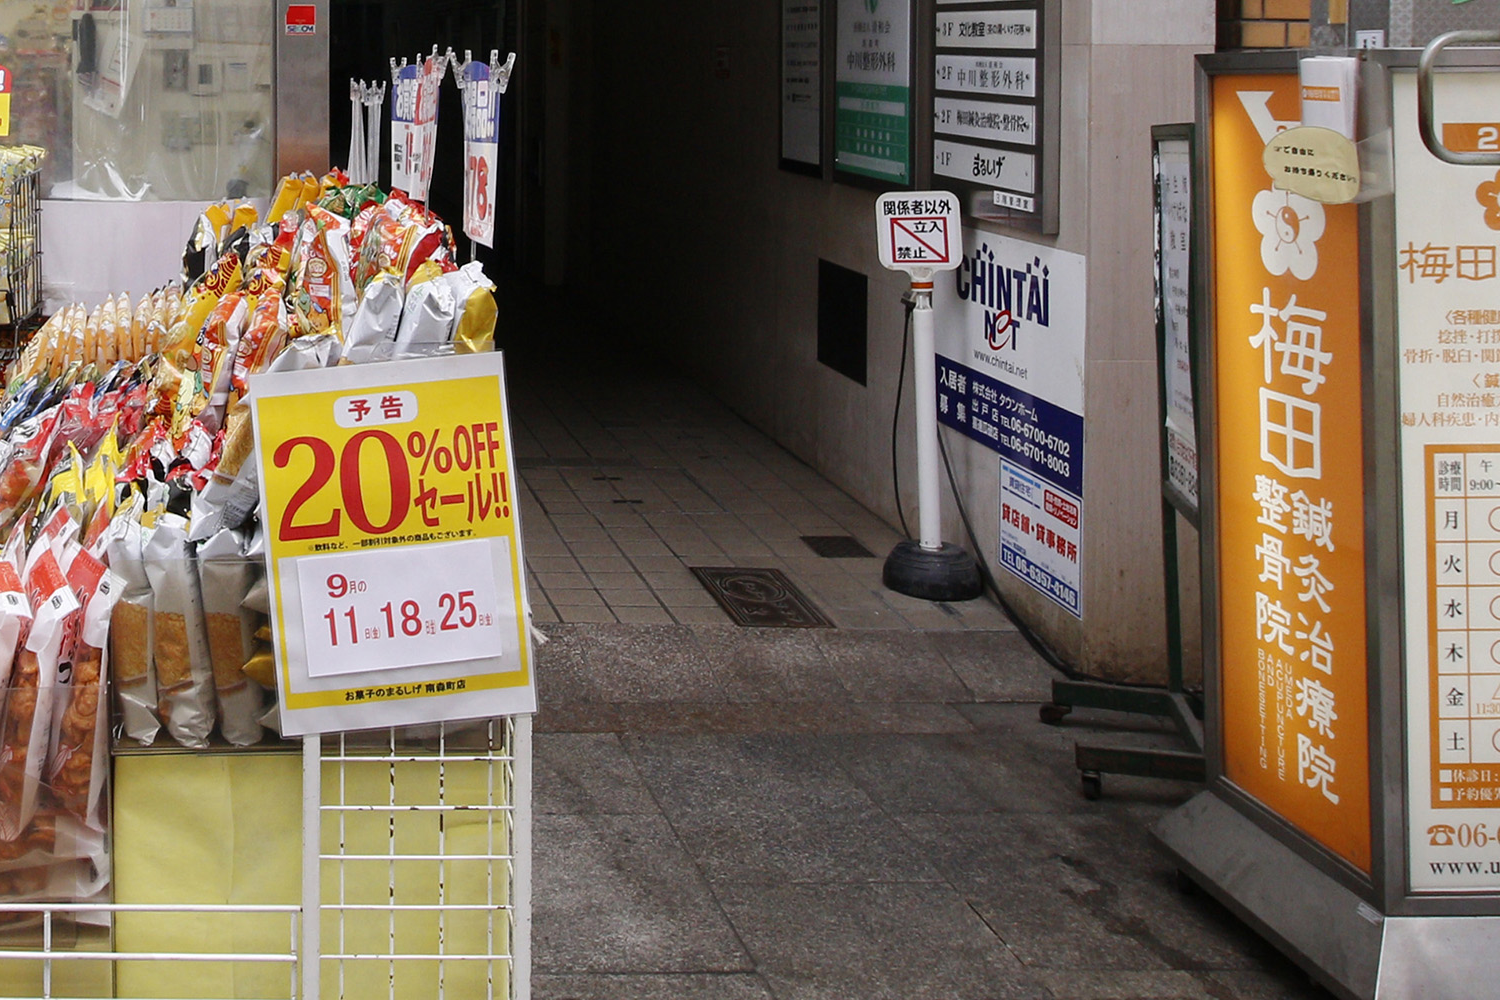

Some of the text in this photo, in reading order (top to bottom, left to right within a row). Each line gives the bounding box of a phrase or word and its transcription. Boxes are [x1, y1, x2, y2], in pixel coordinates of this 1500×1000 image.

[942, 22, 986, 38] 3F 文化教室
[941, 67, 1026, 89] 2F 中川整形外科
[941, 109, 952, 124] 2F
[941, 151, 1006, 178] 1F まるしげ
[882, 199, 953, 215] 関係者以外
[913, 219, 944, 234] 立入
[896, 246, 928, 260] 禁止
[1399, 241, 1497, 284] 梅田
[974, 349, 1028, 380] www.chintai.net
[939, 366, 967, 395] 入居者
[1248, 286, 1333, 480] 梅田
[348, 395, 404, 423] 予告
[939, 393, 967, 422] 募集
[972, 381, 1039, 423] 株式会社 タウンホーム
[1438, 459, 1493, 475] 診療 午
[1438, 477, 1462, 492] 時間
[413, 471, 510, 528] セール!!
[1443, 510, 1458, 530] 月
[1002, 502, 1078, 565] 貸店舗・貸事務所
[1252, 473, 1295, 657] 整骨院
[1443, 554, 1462, 574] 火
[326, 573, 368, 599] 9月の
[1003, 549, 1077, 608] TEL 06-6357-4146
[1444, 598, 1463, 619] 水
[1290, 488, 1340, 806] 鍼灸治療院
[1445, 642, 1464, 663] 木
[1266, 653, 1275, 687] AND
[345, 679, 467, 702] お菓子のまるしげ 南森町店
[1284, 662, 1294, 721] UMEDA
[1446, 687, 1465, 707] 金
[1257, 647, 1268, 770] BONESETTING
[1276, 658, 1286, 782] ACUPUNCTURE
[1447, 731, 1466, 751] 土
[1457, 822, 1500, 848] 06-
